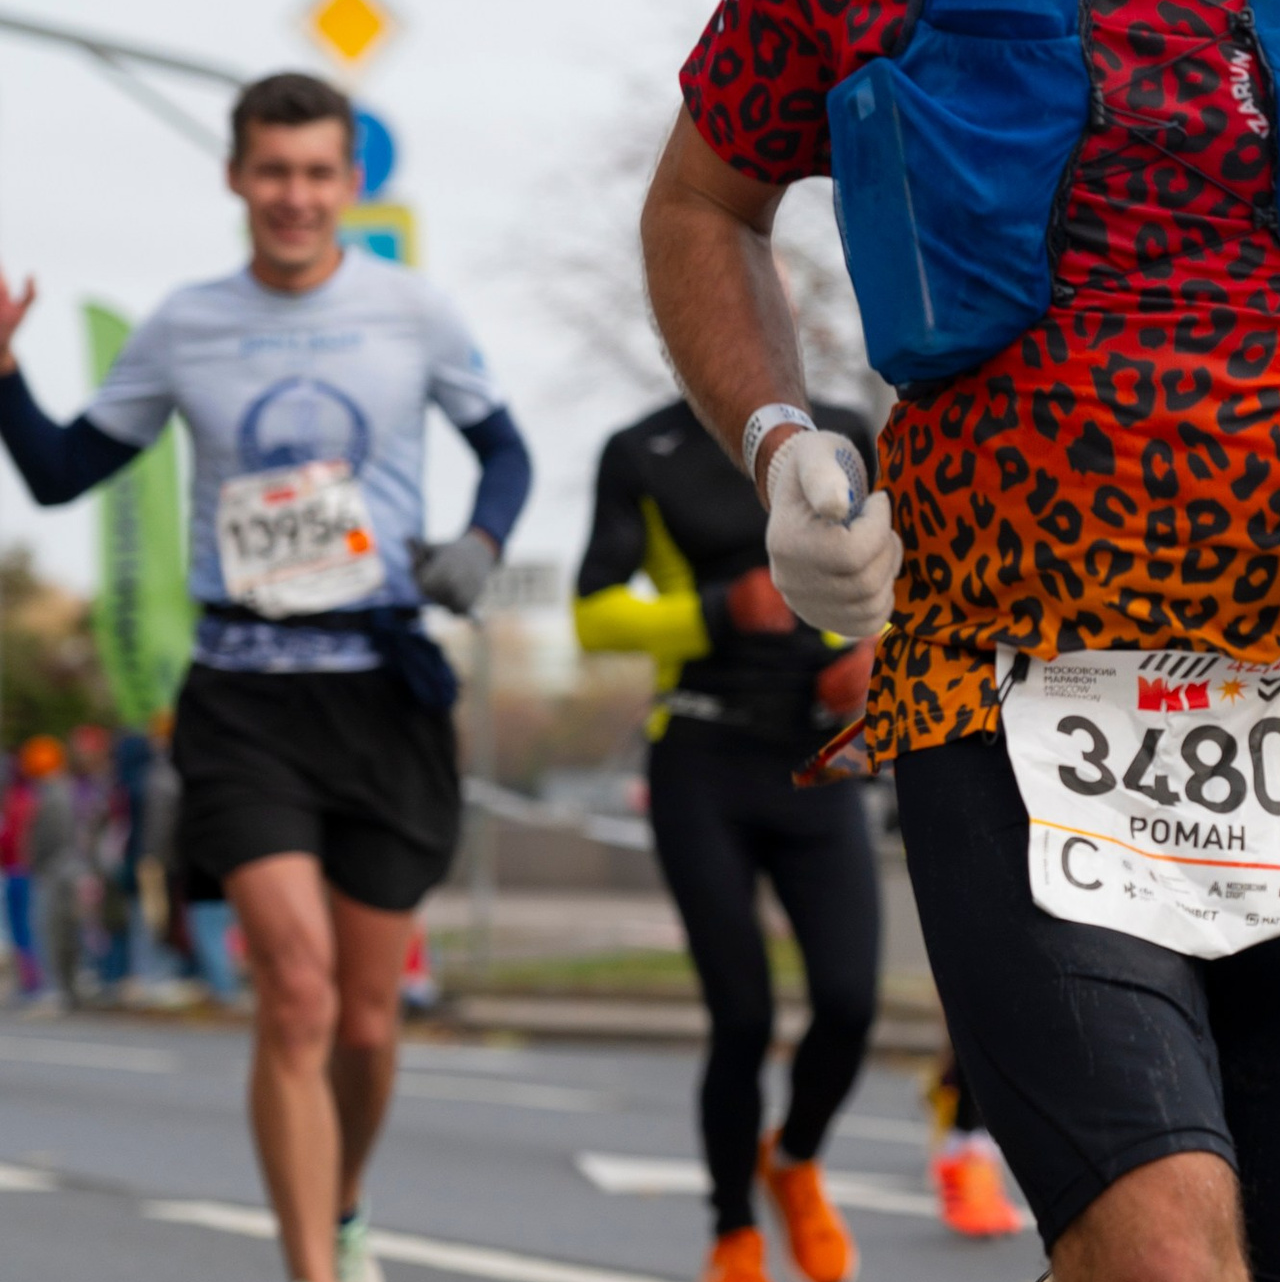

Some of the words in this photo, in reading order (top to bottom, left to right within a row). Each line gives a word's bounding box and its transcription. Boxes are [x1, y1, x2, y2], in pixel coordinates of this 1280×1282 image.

[1044, 665, 1117, 677] МОСКОВСКИЙ
[1044, 675, 1097, 684] МАРАФОН
[1130, 816, 1246, 852] РОМАН
